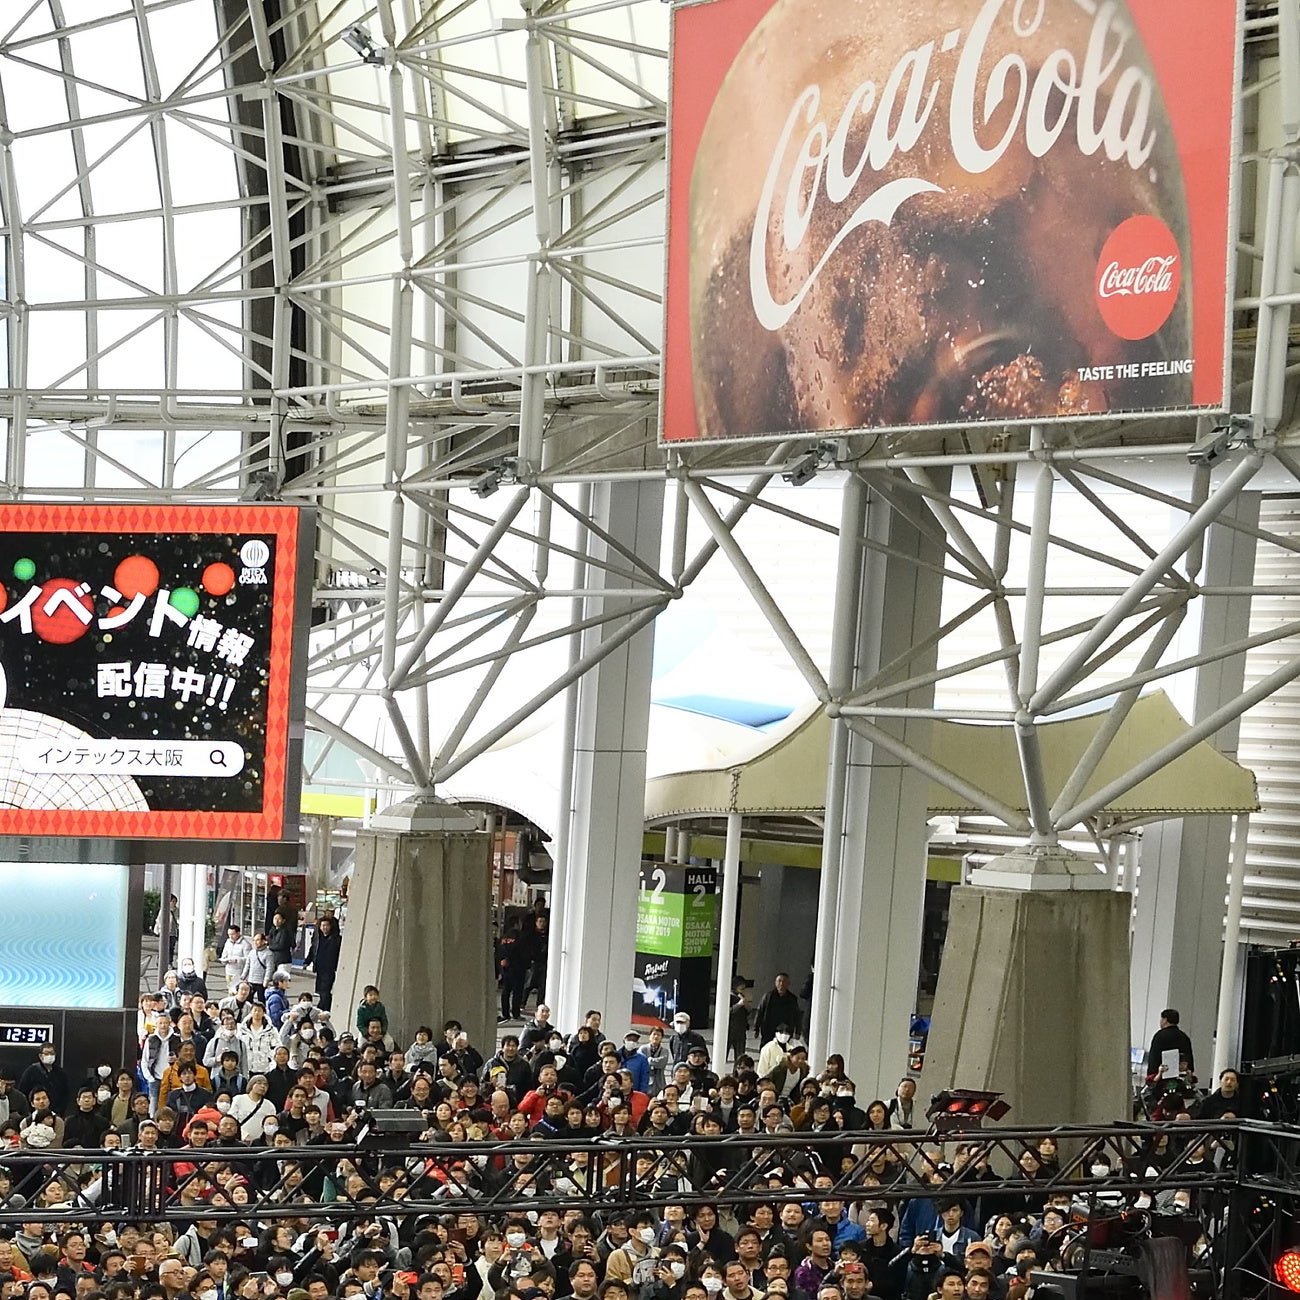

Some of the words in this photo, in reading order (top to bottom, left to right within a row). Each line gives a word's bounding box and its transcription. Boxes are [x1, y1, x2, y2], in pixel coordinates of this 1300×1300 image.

[750, 0, 1158, 330] Coca-Cola
[1099, 255, 1177, 297] Coca-Cola
[1078, 366, 1113, 381] TASTE
[1116, 363, 1140, 378] THE
[1141, 359, 1193, 377] FEELING
[238, 574, 268, 584] OSAKA
[96, 662, 236, 710] 配信中!!
[38, 747, 183, 767] インテックス大阪
[687, 874, 714, 884] HALL
[651, 868, 667, 905] 2
[692, 885, 706, 907] 2
[656, 915, 680, 928] MOTOR
[685, 921, 711, 930] OSAKA
[636, 923, 655, 934] SHOW
[656, 926, 671, 936] 2019
[685, 930, 710, 938] MOTOR
[684, 937, 708, 946] SHOW
[6, 1028, 46, 1041] 12:34
